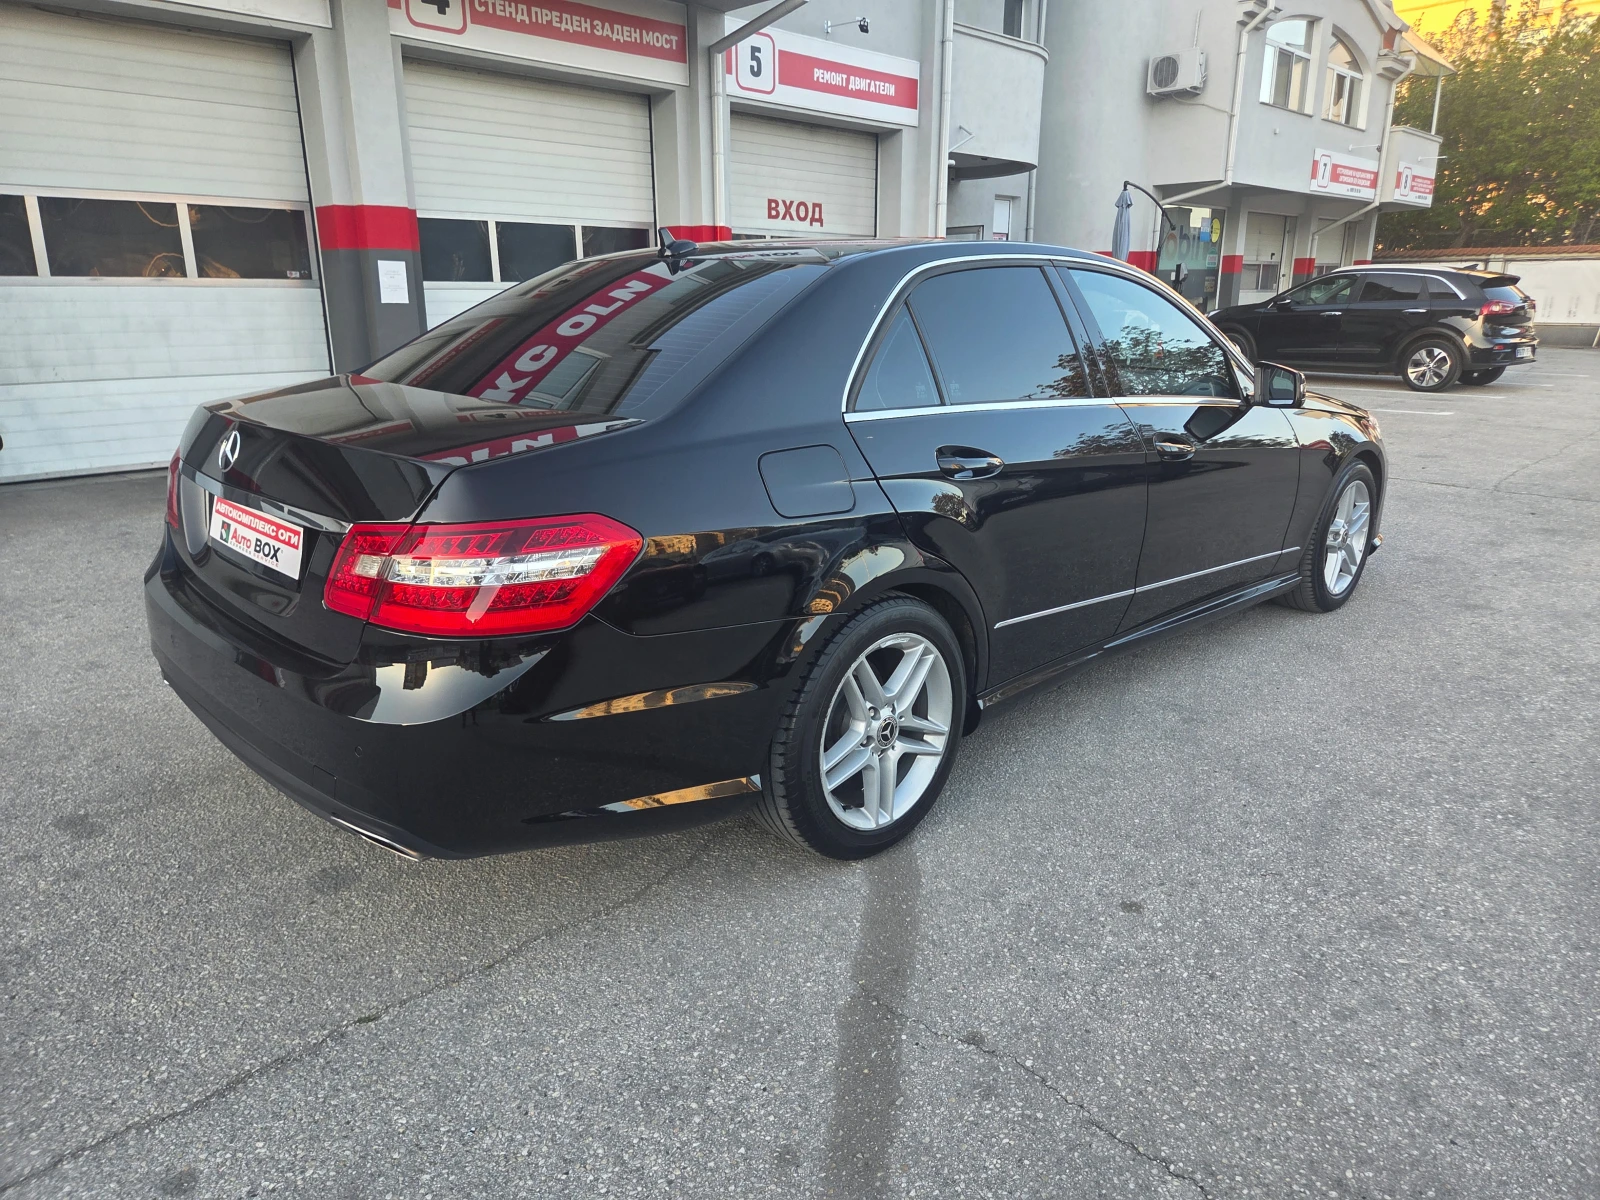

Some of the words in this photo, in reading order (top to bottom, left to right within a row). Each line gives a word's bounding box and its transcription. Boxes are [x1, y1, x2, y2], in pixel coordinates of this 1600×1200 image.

[474, 0, 529, 24] СТЕНД
[531, 7, 591, 33] ПРЕДЕН
[593, 20, 640, 43] ЗАДЕН
[642, 30, 678, 50] МОСТ
[749, 45, 762, 78] 5
[813, 68, 847, 87] РЕМОНТ
[849, 76, 895, 97] ДВИГАТЕЛИ
[1321, 163, 1328, 180] 7
[767, 198, 824, 227] ВХОД
[216, 501, 277, 535] АВТОКОМПЛЕКС
[278, 530, 299, 546] ОГИ
[253, 553, 280, 568] SERVICE
[254, 537, 281, 563] BOX
